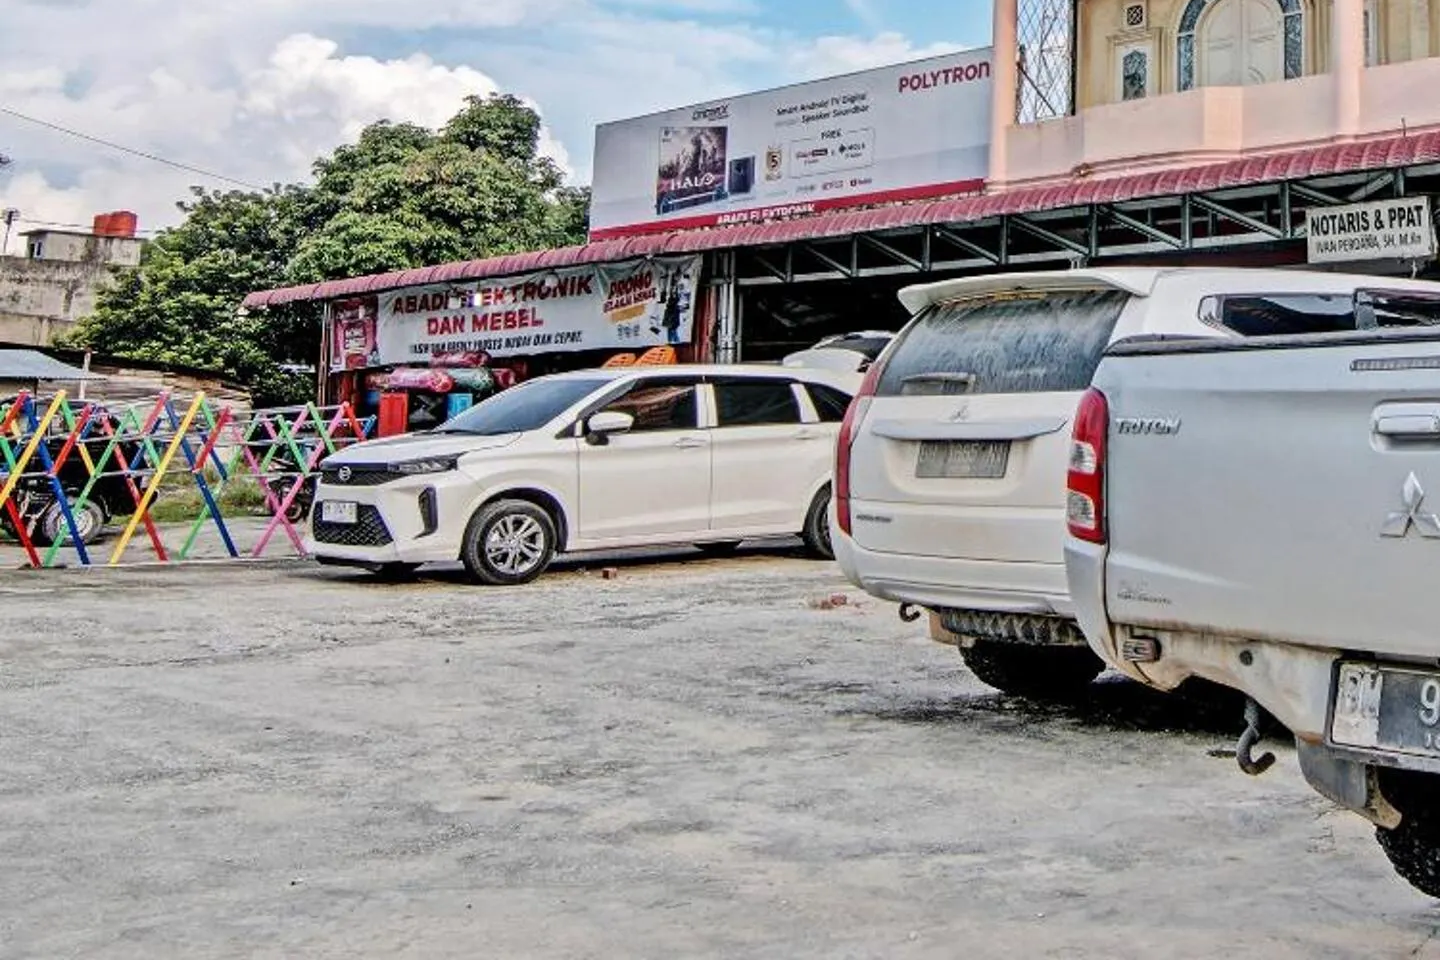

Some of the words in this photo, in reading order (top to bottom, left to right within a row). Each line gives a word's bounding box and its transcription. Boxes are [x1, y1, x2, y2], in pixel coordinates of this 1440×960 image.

[898, 61, 990, 93] POLYTRON
[1311, 211, 1370, 237] NOTARIS
[1374, 209, 1385, 230] &
[1389, 205, 1424, 229] PPAT
[393, 294, 450, 315] ABADI
[459, 274, 594, 308] EEKTRONIK
[427, 315, 465, 336] DAN
[472, 307, 544, 333] MEBEL
